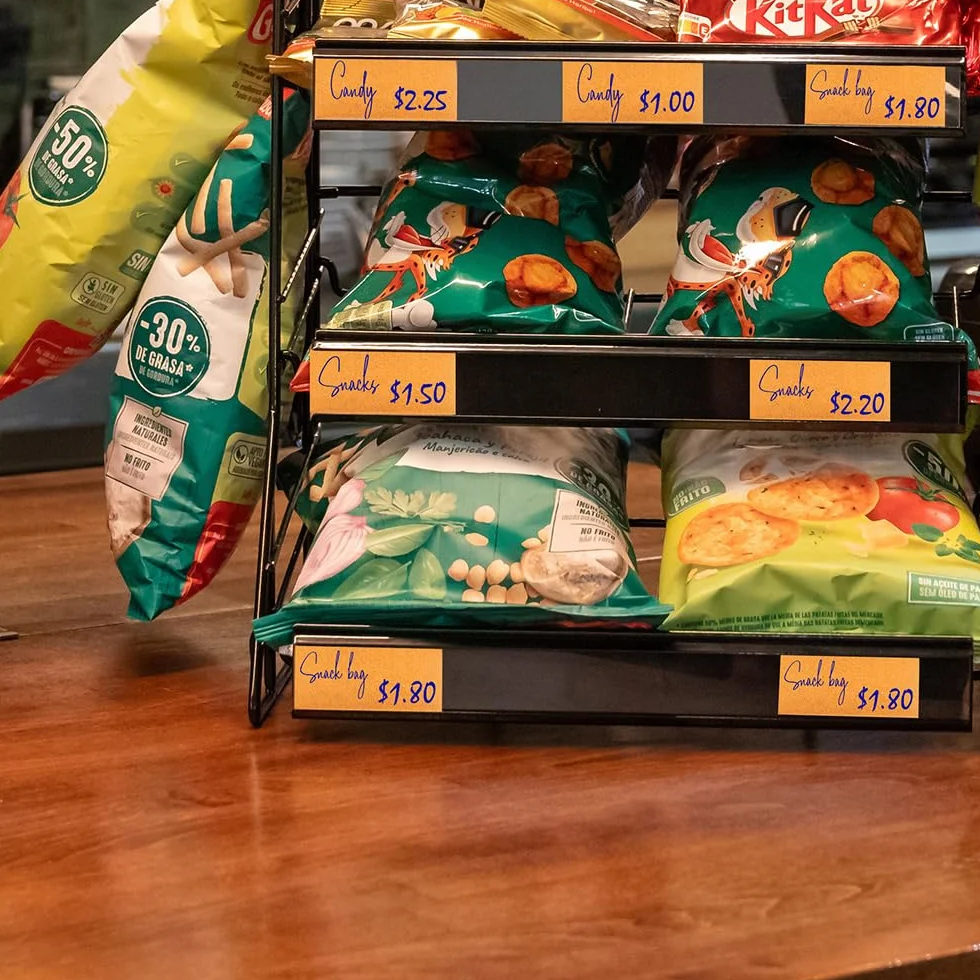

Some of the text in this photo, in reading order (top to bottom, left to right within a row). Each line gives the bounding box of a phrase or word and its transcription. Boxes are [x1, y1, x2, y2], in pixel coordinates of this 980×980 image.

[330, 59, 377, 120] Candy
[394, 86, 448, 111] $2.25
[577, 63, 624, 123] Candy
[639, 88, 695, 114] $1.00
[809, 68, 876, 115] Snack bag
[884, 96, 940, 121] $1.80
[127, 252, 152, 272] SIN
[101, 280, 119, 295] SIN
[140, 311, 201, 355] -30%
[135, 344, 148, 363] DE
[318, 354, 380, 397] Snacks
[758, 363, 814, 401] Snacks
[390, 380, 446, 405] $1.50
[829, 391, 885, 415] $2.20
[132, 425, 168, 447] NATURALES
[124, 453, 151, 472] NO FRITO
[674, 485, 710, 511] FRITO
[581, 527, 616, 540] NO FRITO
[918, 577, 931, 586] SIN
[933, 578, 959, 590] ACEITE
[300, 650, 368, 699] Snack bag
[783, 659, 850, 706] Snack bag
[378, 679, 437, 706] $1.80
[857, 687, 914, 712] $1.80
